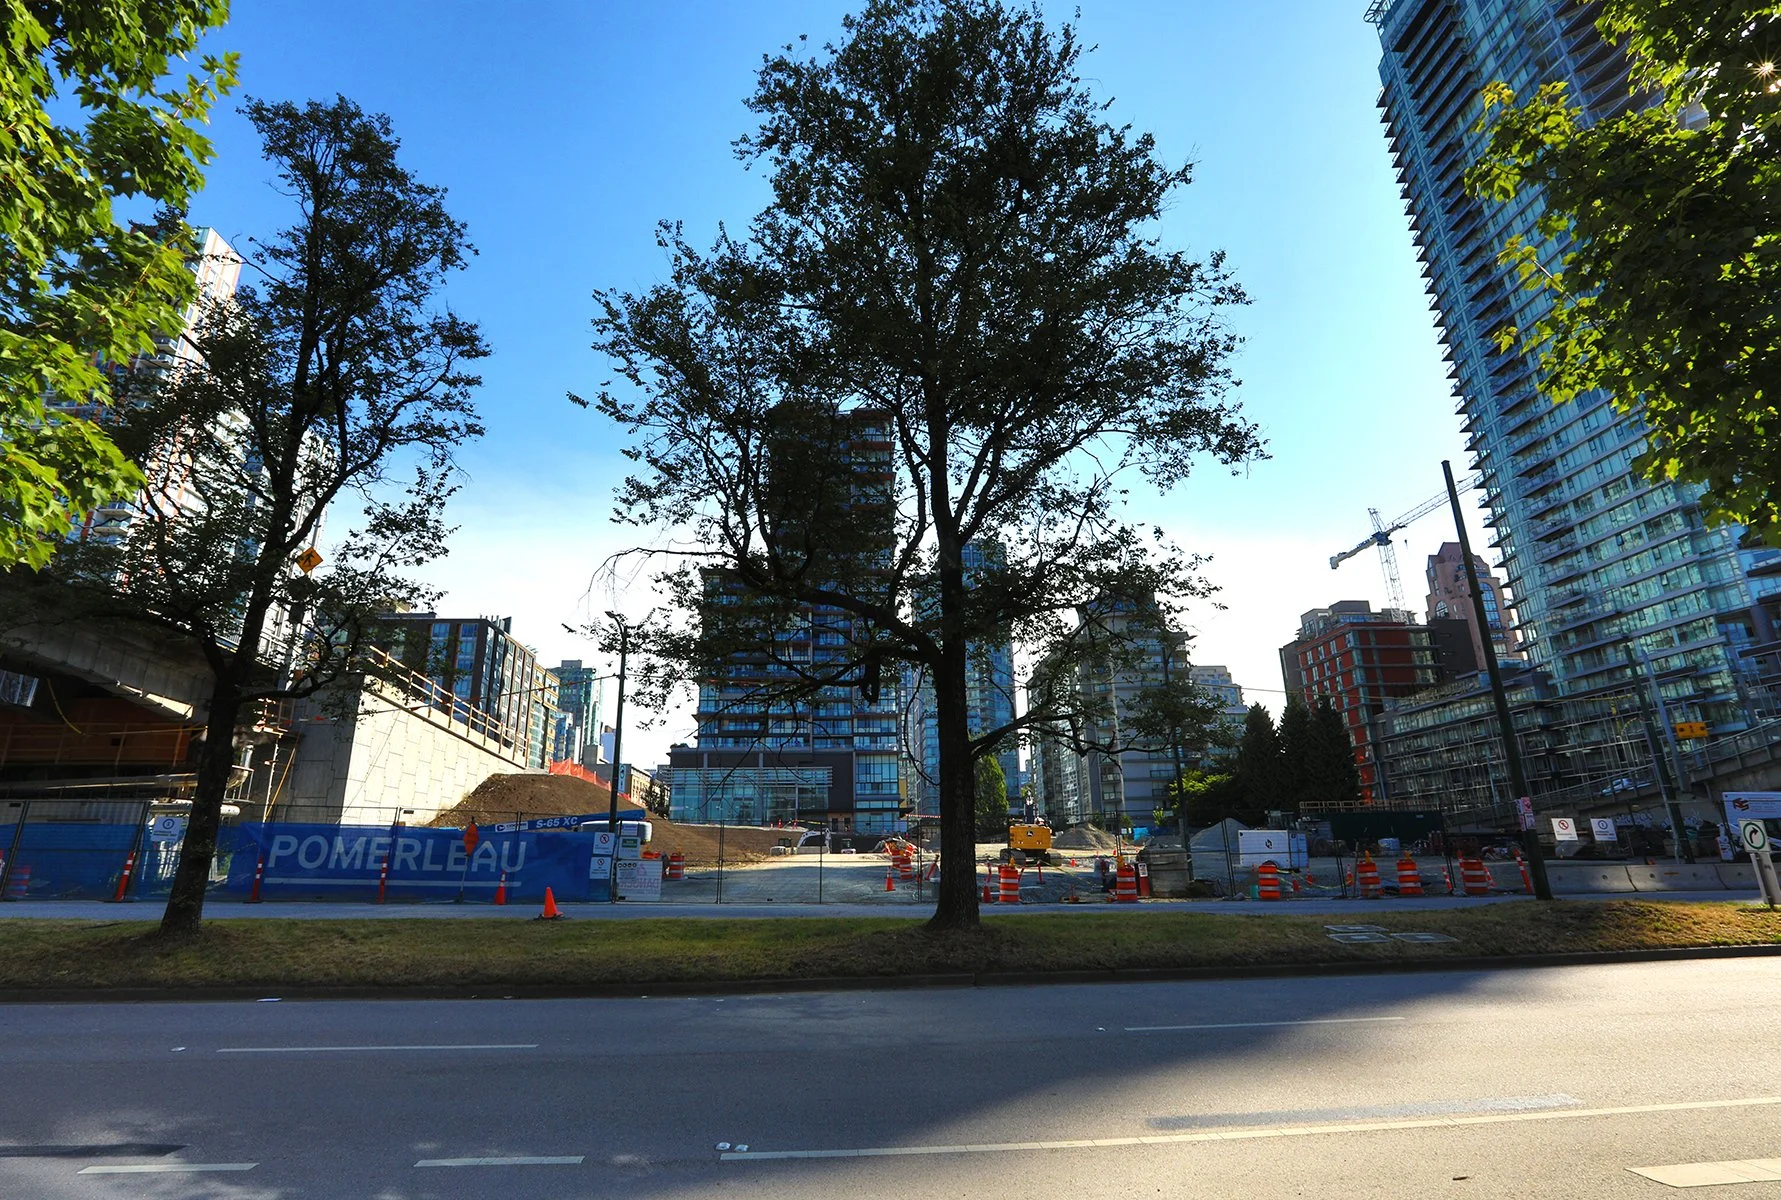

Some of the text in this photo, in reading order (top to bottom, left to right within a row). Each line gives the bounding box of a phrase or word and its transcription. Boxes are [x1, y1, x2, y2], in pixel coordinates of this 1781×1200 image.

[536, 818, 560, 829] S-65
[563, 816, 578, 826] XC
[268, 835, 526, 872] POMERLEAU
